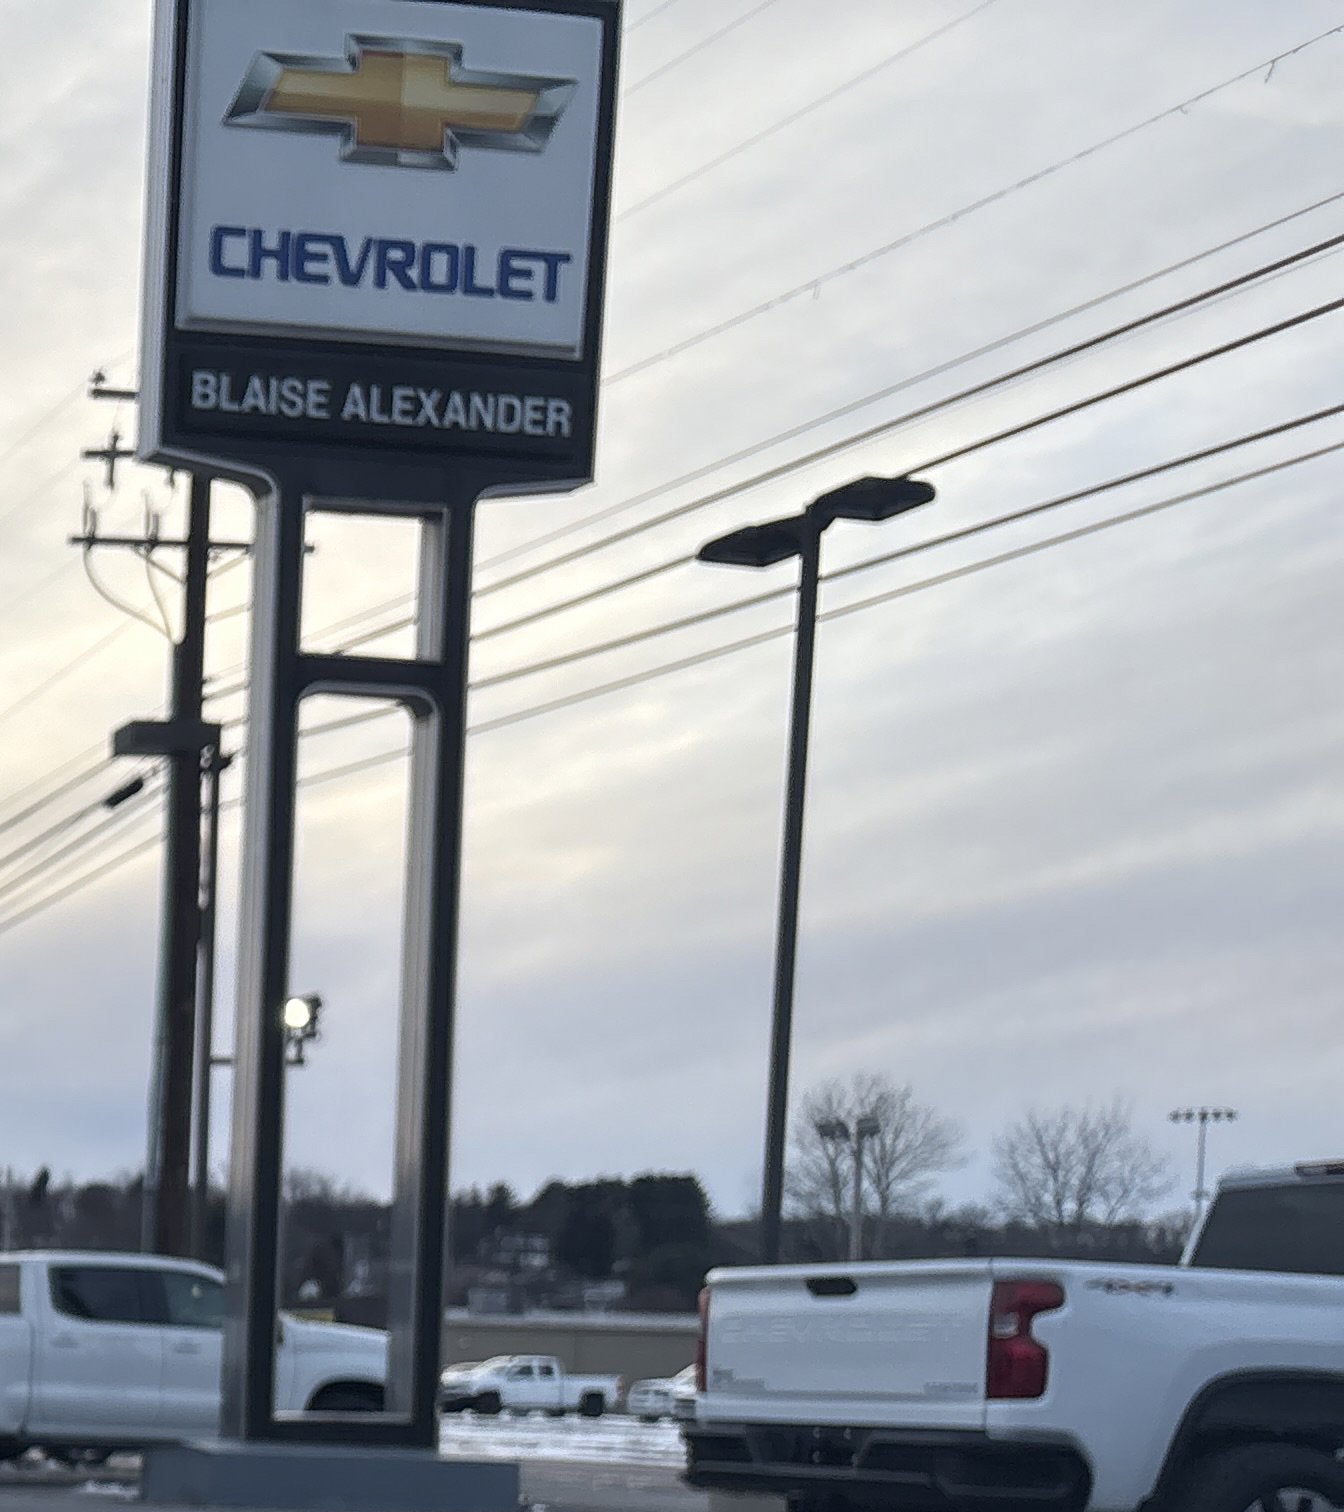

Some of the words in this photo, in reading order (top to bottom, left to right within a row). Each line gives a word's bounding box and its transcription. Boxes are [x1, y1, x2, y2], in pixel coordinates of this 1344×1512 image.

[210, 226, 572, 302] CHEVROLET
[191, 370, 331, 420] BLAISE
[340, 383, 573, 437] ALEXANDER
